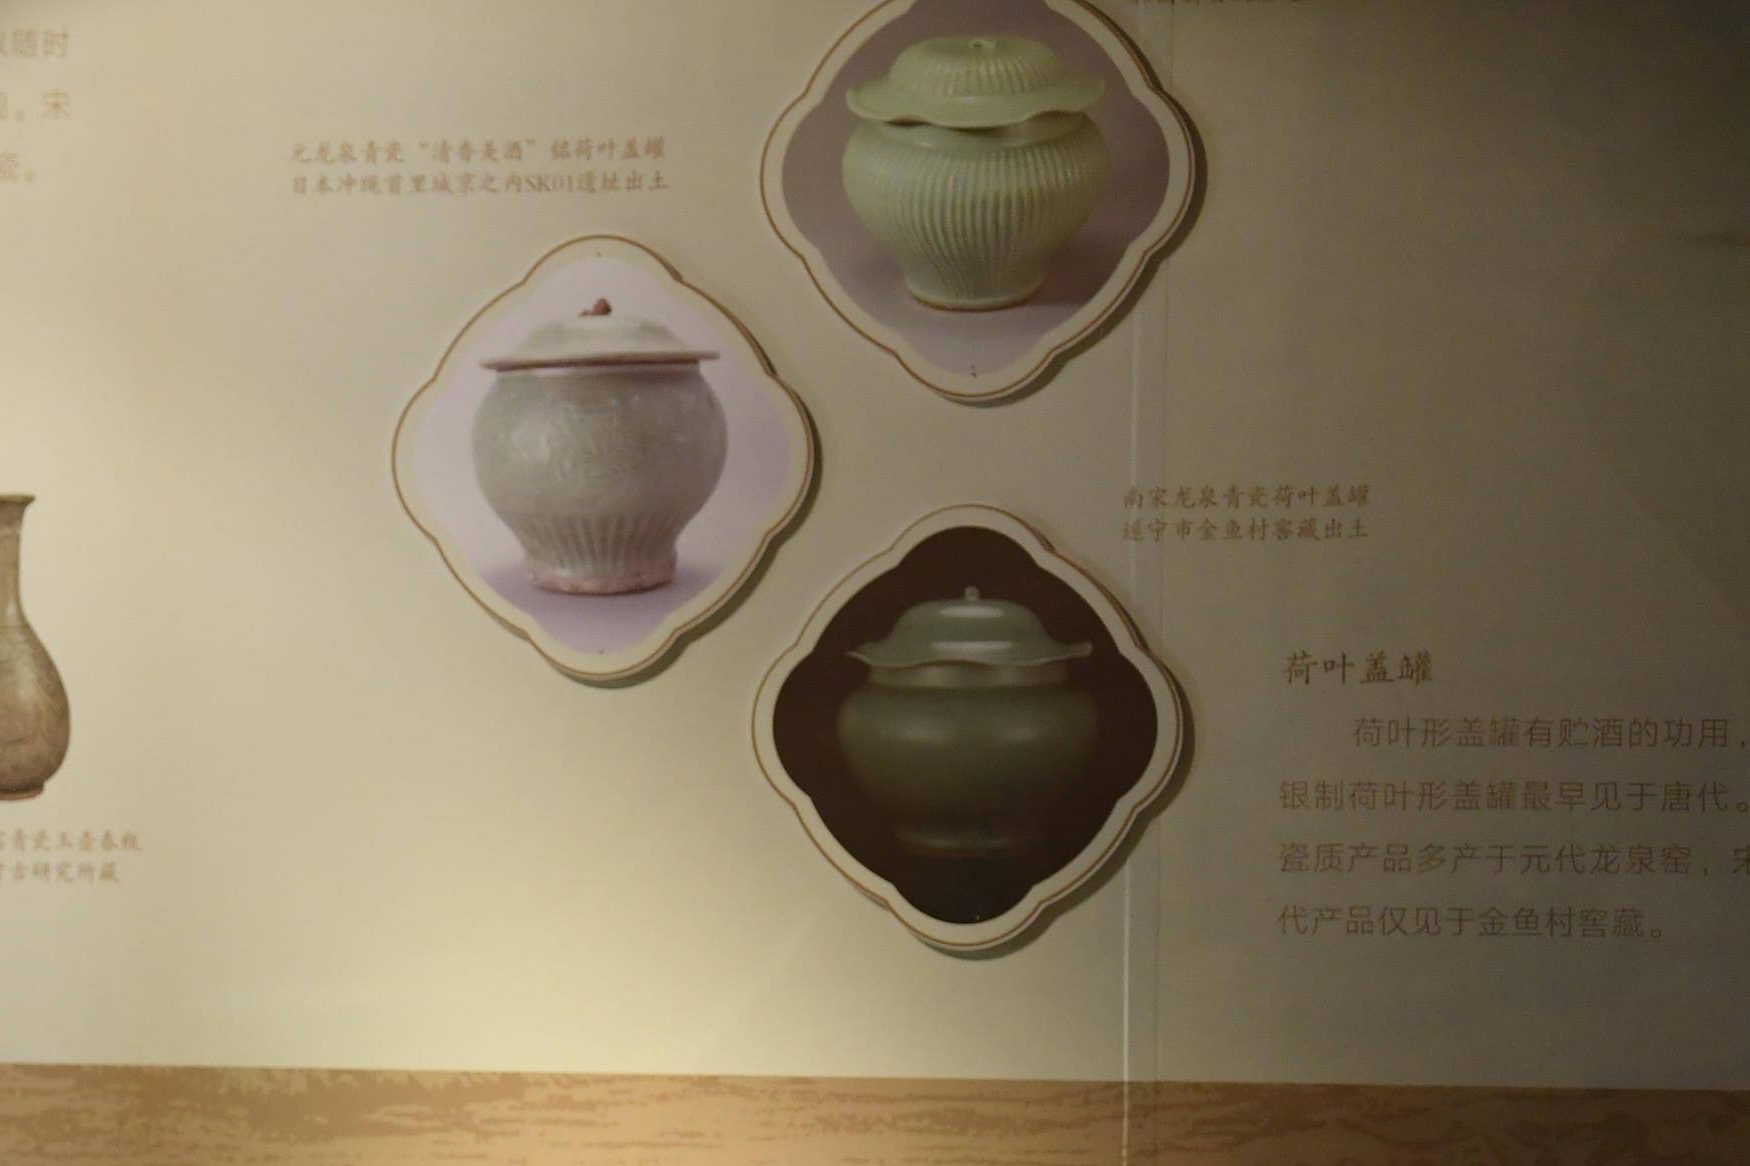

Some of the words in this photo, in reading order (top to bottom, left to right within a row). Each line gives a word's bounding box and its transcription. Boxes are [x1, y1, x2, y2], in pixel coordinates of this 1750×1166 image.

[1123, 484, 1369, 510] 南宋龙泉青瓷荷叶盖罐
[1122, 518, 1369, 542] 遂宁市金鱼村窖藏出土
[1283, 649, 1434, 685] 荷叶盖罐
[1352, 716, 1746, 749] 荷叶形盖罐有贮酒的功用，
[1279, 781, 1749, 813] 银制荷叶形盖罐最早见于唐代。
[1278, 905, 1663, 939] 代产品仅见于金鱼村窖藏。
